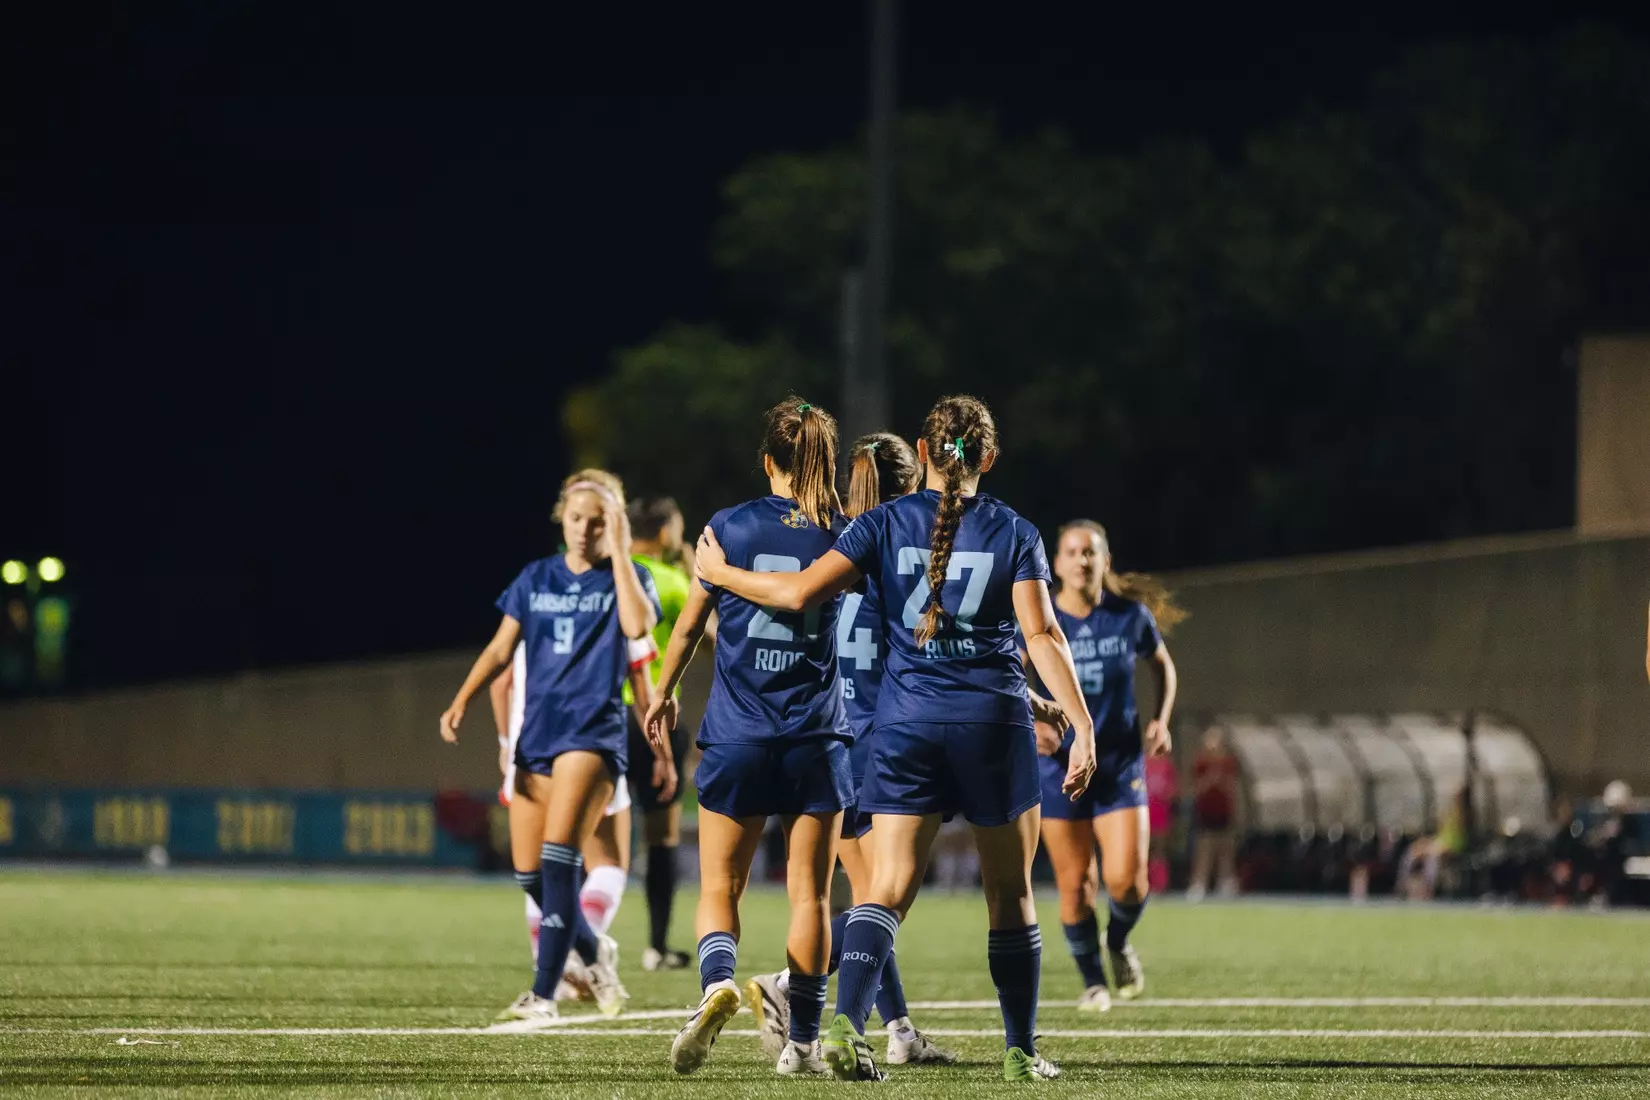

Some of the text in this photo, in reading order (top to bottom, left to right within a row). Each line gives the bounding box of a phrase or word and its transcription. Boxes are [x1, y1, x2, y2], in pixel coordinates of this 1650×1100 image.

[897, 547, 995, 632] 27
[579, 592, 614, 612] CITY
[553, 617, 575, 654] 9
[925, 637, 976, 659] ROOS
[843, 952, 878, 967] ROOS
